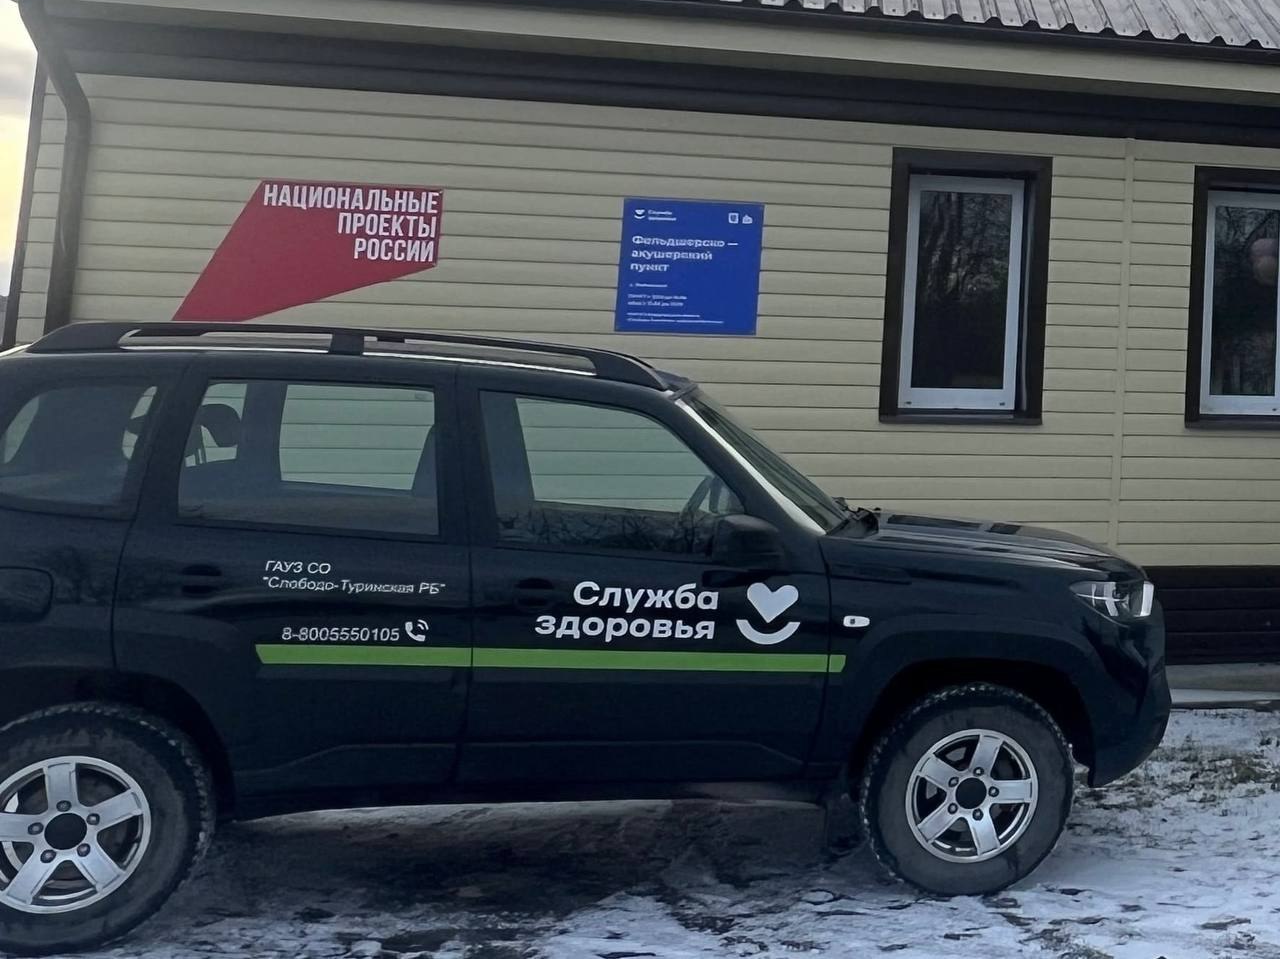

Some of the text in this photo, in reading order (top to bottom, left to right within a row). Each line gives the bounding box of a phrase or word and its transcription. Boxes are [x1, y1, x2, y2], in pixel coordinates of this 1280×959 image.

[263, 184, 440, 214] НАЦИОНАЛЬНЫЕ
[337, 212, 437, 238] ПРОЕКТЫ
[353, 238, 434, 262] РОССИИ
[630, 263, 669, 272] пункт
[265, 560, 331, 574] ГАУЗ СО
[573, 581, 719, 613] Служба
[281, 627, 400, 641] 8-8005550105
[534, 615, 715, 642] здоровья
